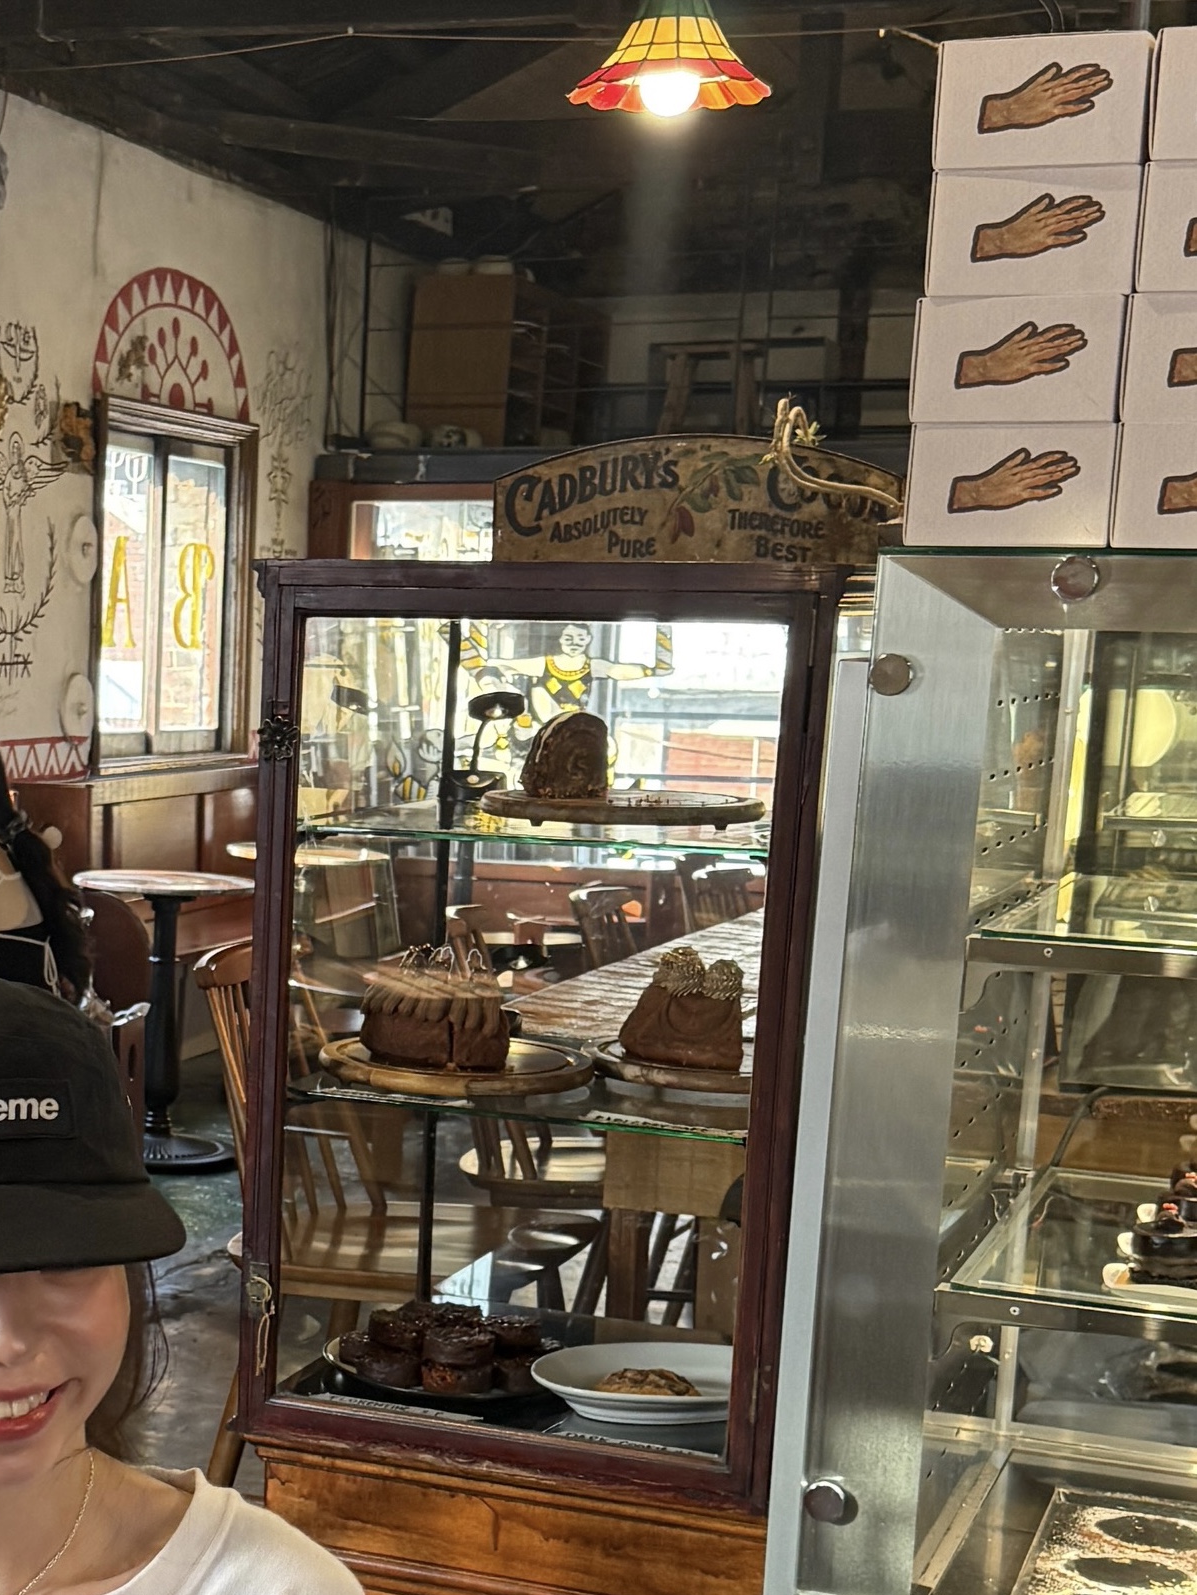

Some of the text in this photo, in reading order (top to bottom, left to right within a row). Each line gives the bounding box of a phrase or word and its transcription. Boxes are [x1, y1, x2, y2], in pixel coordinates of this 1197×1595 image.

[550, 506, 649, 543] ABSOLUTELY
[728, 508, 826, 539] THEREFORE
[608, 531, 656, 559] PURE
[755, 536, 812, 563] BEST
